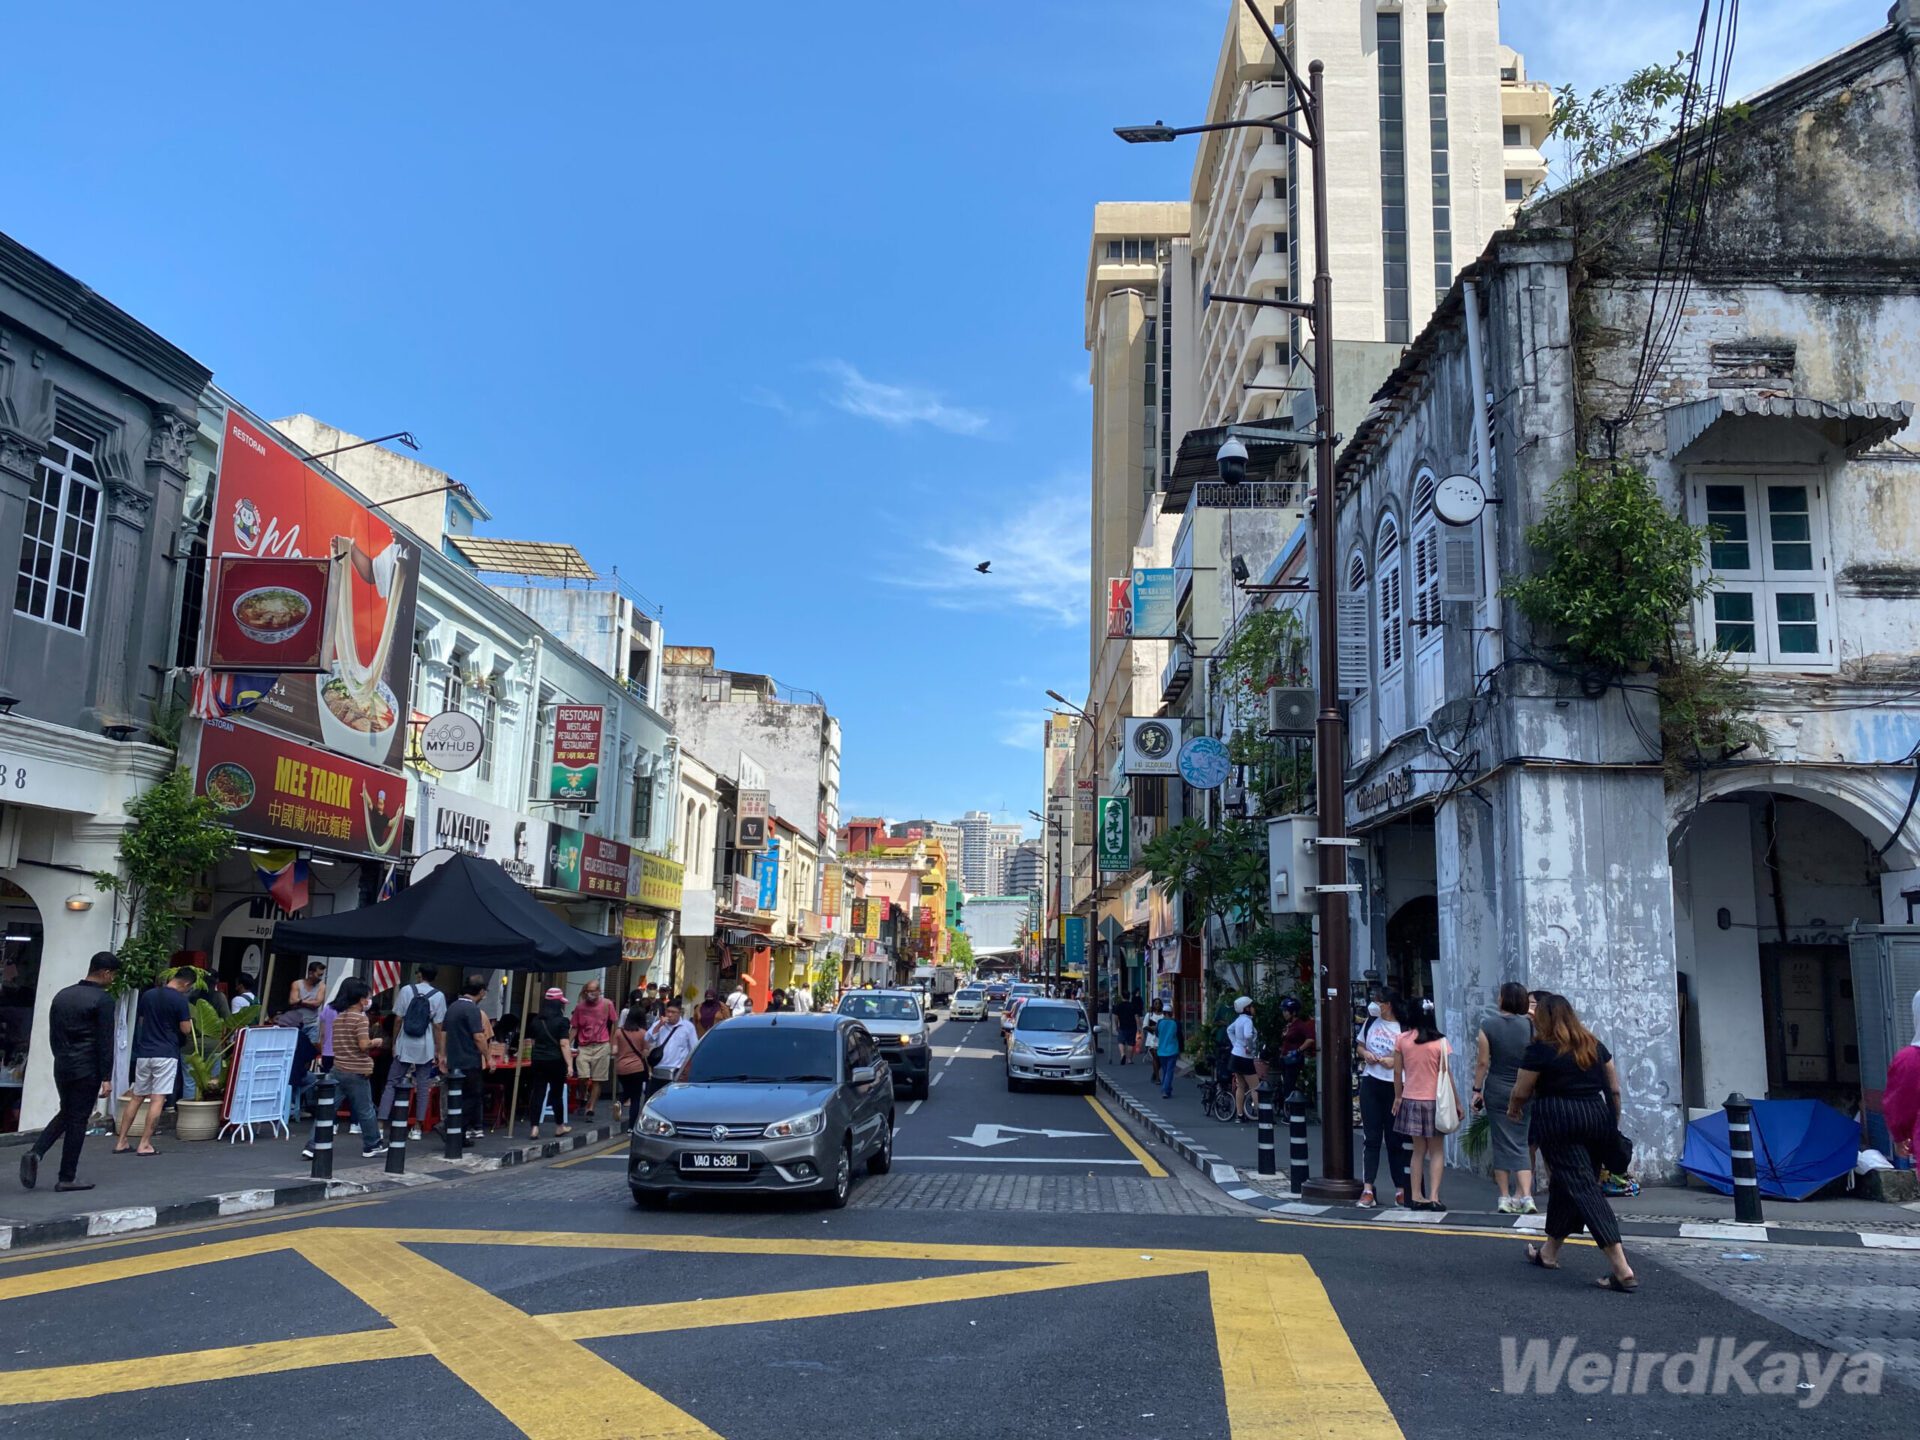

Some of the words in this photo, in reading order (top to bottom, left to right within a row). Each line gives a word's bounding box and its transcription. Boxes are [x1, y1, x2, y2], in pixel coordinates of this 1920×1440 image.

[233, 425, 266, 456] RESTORAN
[559, 710, 600, 721] RESTORAN
[426, 741, 475, 752] MYHUB
[274, 755, 308, 798] MEE
[310, 766, 353, 810] TARIK
[437, 808, 491, 846] MYHUB
[694, 1154, 710, 1167] VAQ
[713, 1155, 737, 1168] 6384
